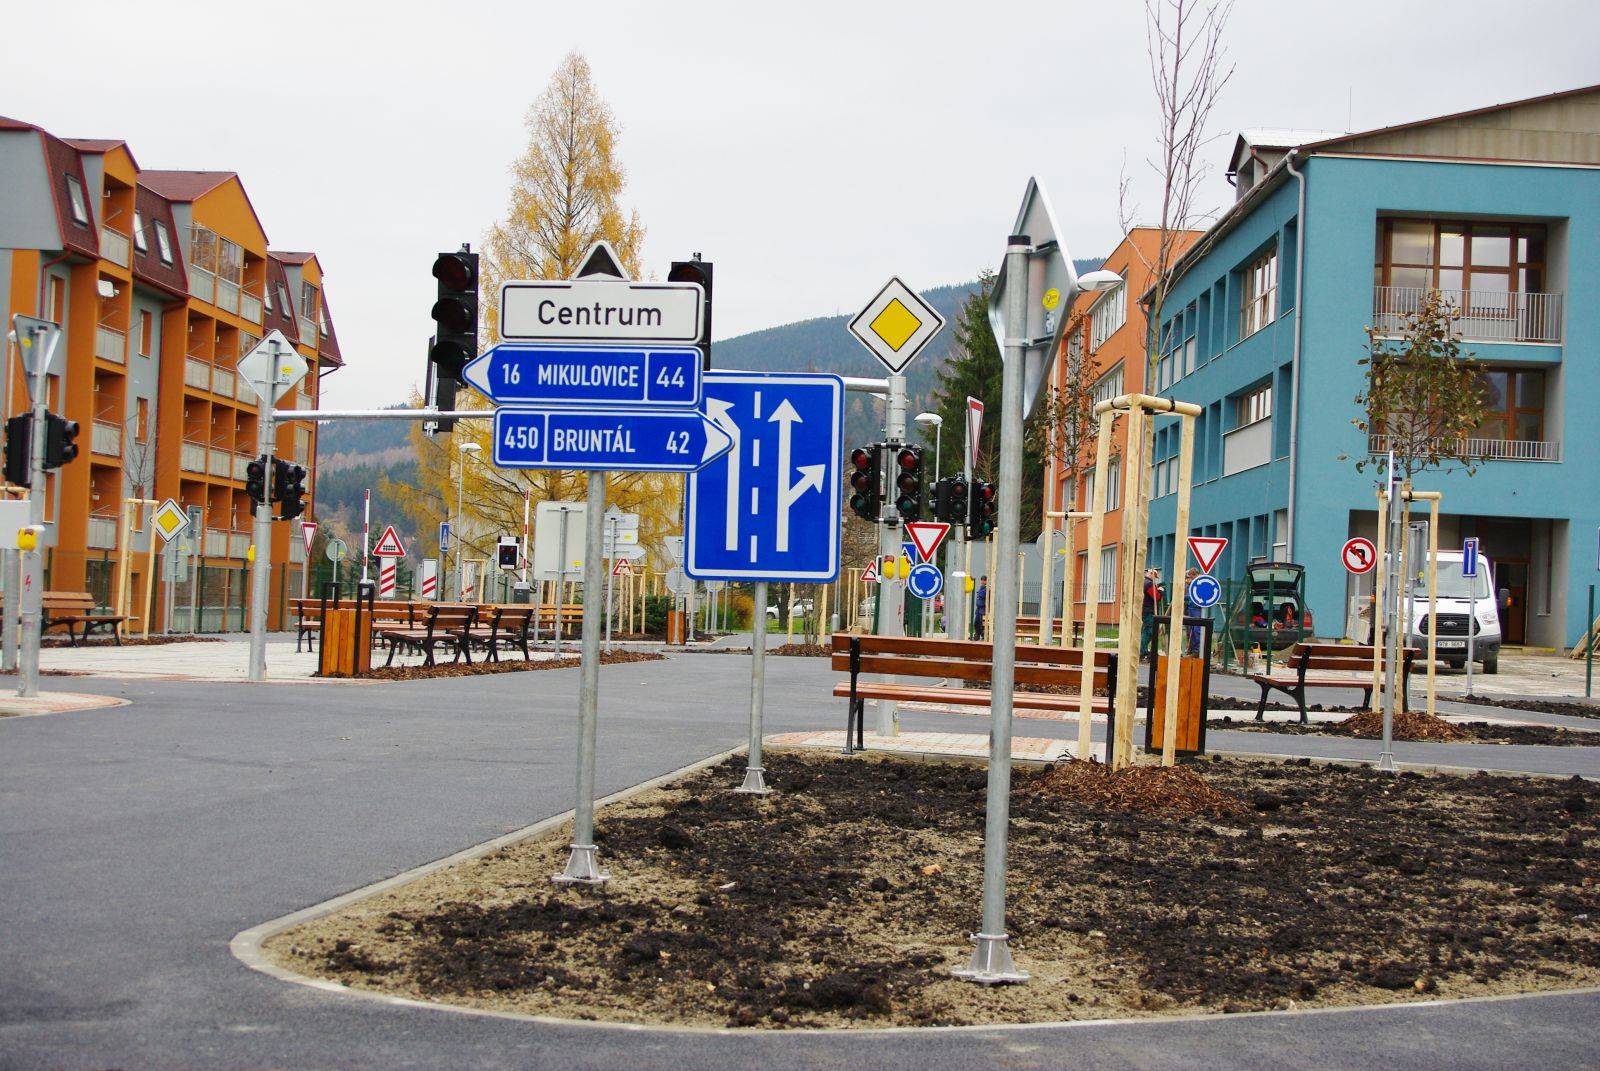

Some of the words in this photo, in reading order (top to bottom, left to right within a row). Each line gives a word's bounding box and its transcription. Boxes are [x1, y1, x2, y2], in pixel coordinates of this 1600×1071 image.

[538, 300, 662, 326] Centrum
[502, 363, 520, 385] 16
[538, 364, 639, 387] MIKULOVICE
[656, 366, 685, 389] 44
[504, 426, 539, 450] 450
[553, 424, 636, 453] BRUNTÁL
[666, 431, 690, 454] 42
